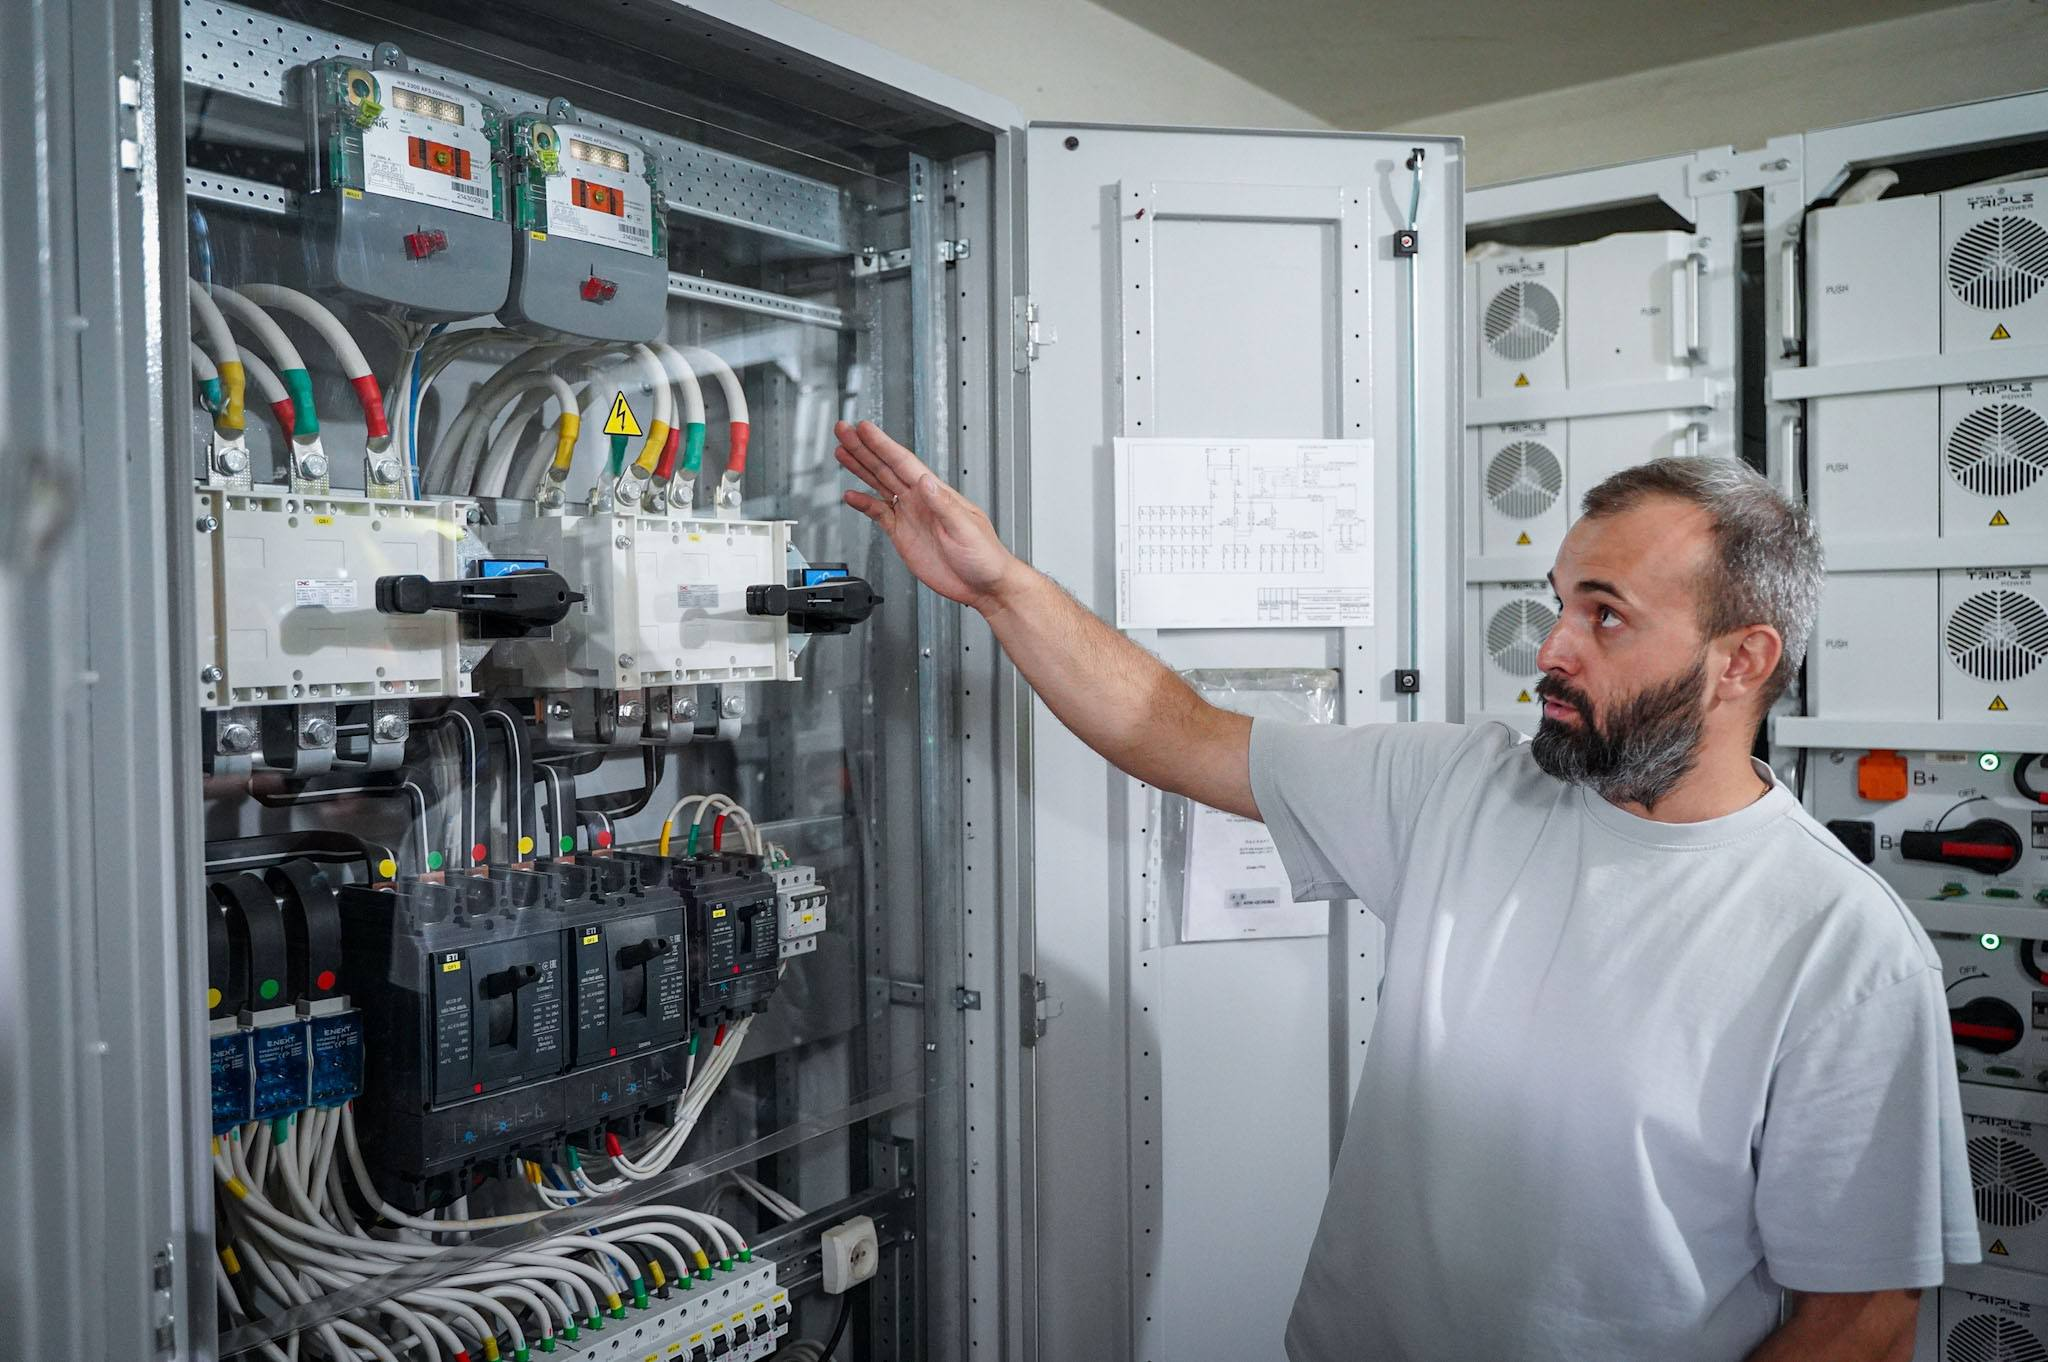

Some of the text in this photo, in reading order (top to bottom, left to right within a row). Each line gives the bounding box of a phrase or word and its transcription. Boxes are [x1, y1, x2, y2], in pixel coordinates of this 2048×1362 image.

[1967, 193, 2033, 210] TRIPLE
[1966, 382, 2032, 396] TRIPLE
[1966, 567, 2031, 580] TRIPLE
[1913, 770, 1938, 786] B+
[585, 927, 597, 936] ETI
[446, 952, 459, 962] ETI
[1966, 1113, 2032, 1131] TRIPLE
[1966, 1291, 2031, 1312] TRIPLE
